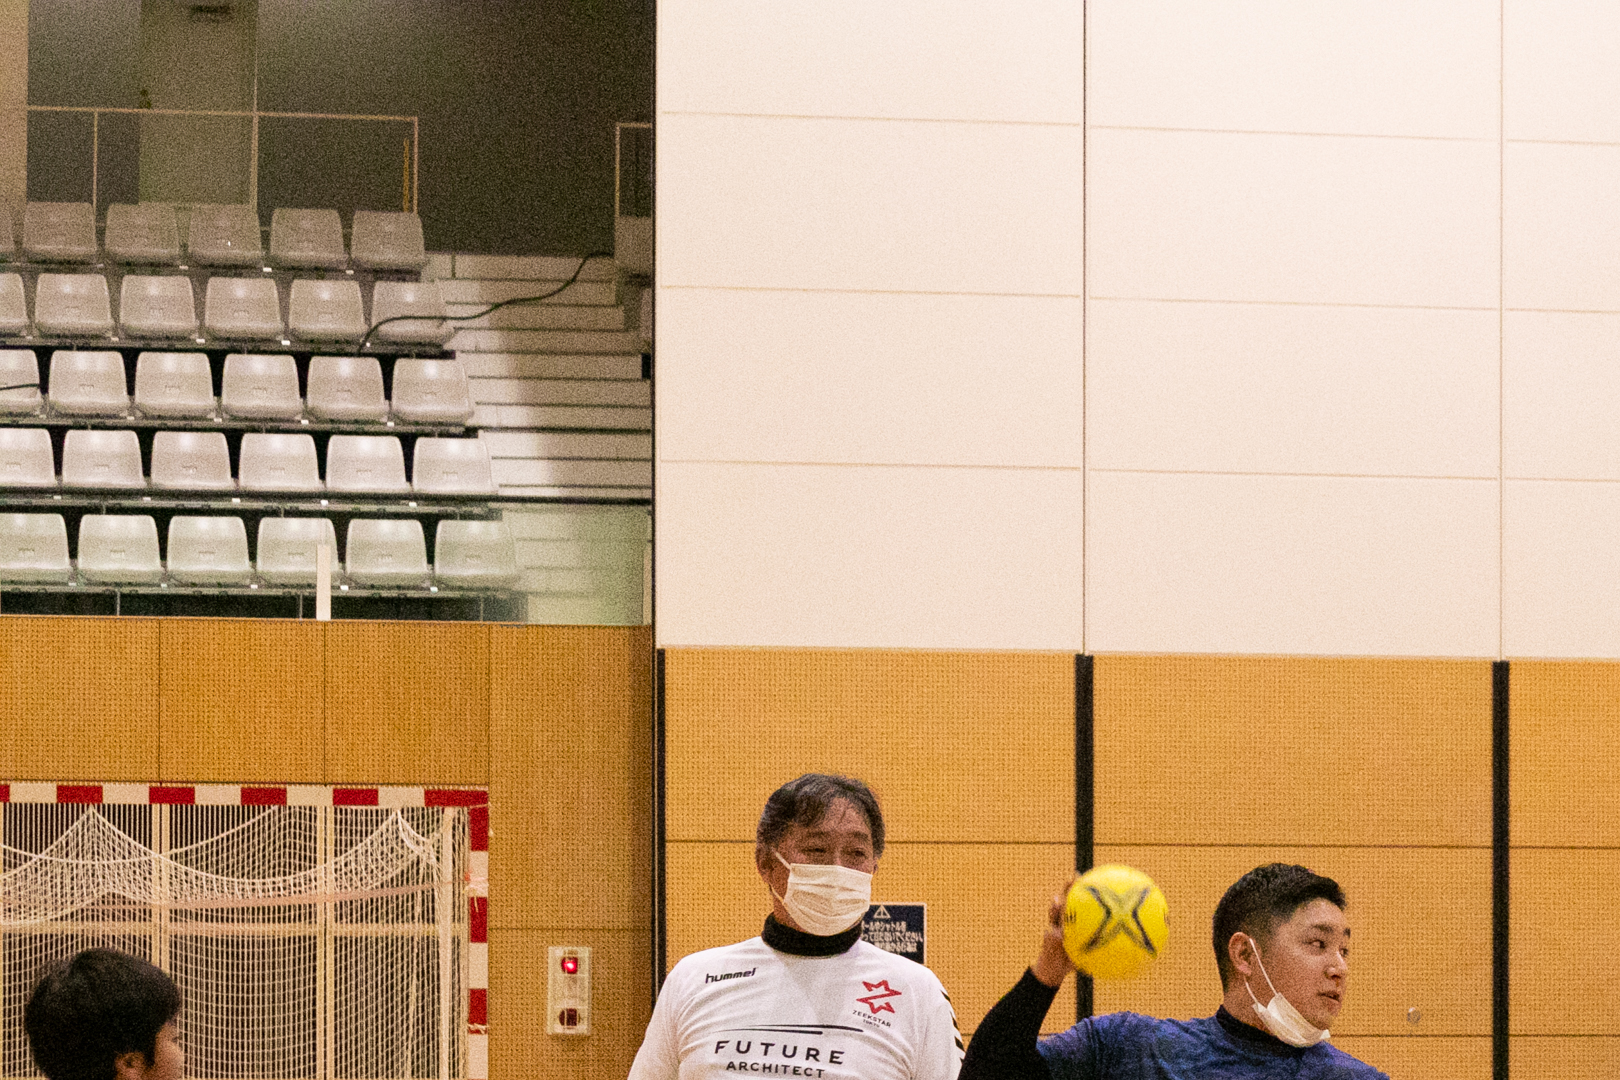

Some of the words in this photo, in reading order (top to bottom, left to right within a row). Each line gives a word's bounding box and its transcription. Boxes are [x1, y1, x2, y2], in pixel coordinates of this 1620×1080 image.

[705, 967, 757, 984] hummel
[852, 1009, 892, 1028] ZEEKSTAR
[714, 1040, 845, 1065] FUTURE
[726, 1061, 825, 1078] ARCHITECT
